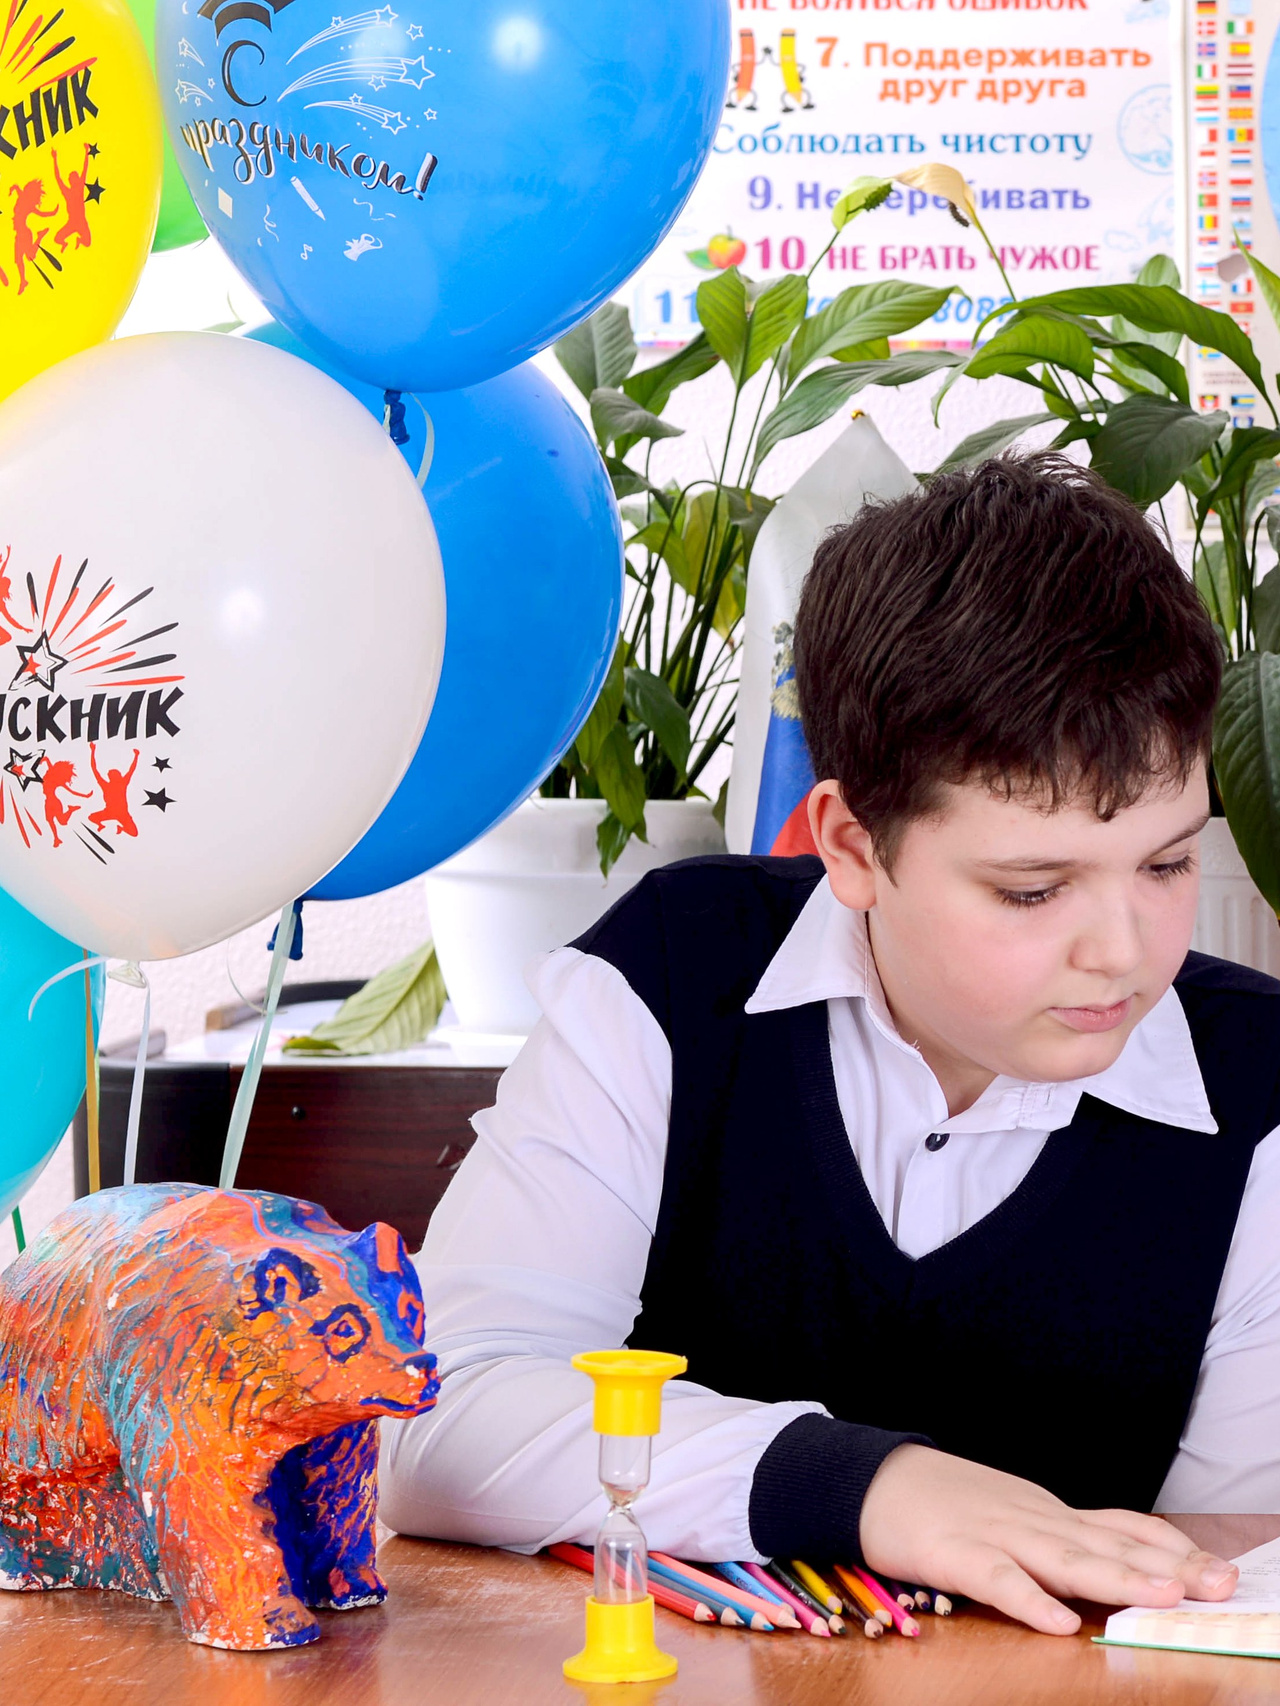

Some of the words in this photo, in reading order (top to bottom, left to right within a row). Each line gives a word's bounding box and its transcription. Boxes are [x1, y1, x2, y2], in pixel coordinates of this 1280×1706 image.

[864, 42, 1153, 73] Поддерживать
[879, 78, 968, 104] друг
[977, 78, 1086, 104] друга
[712, 123, 926, 155] Соблюдать
[940, 133, 1093, 161] чистоту
[746, 176, 782, 210] 9.
[826, 246, 867, 270] НЕ
[879, 246, 976, 270] БРАТЬ
[988, 246, 1100, 270] ЧУЖОЕ
[0, 687, 185, 744] СКНИК
